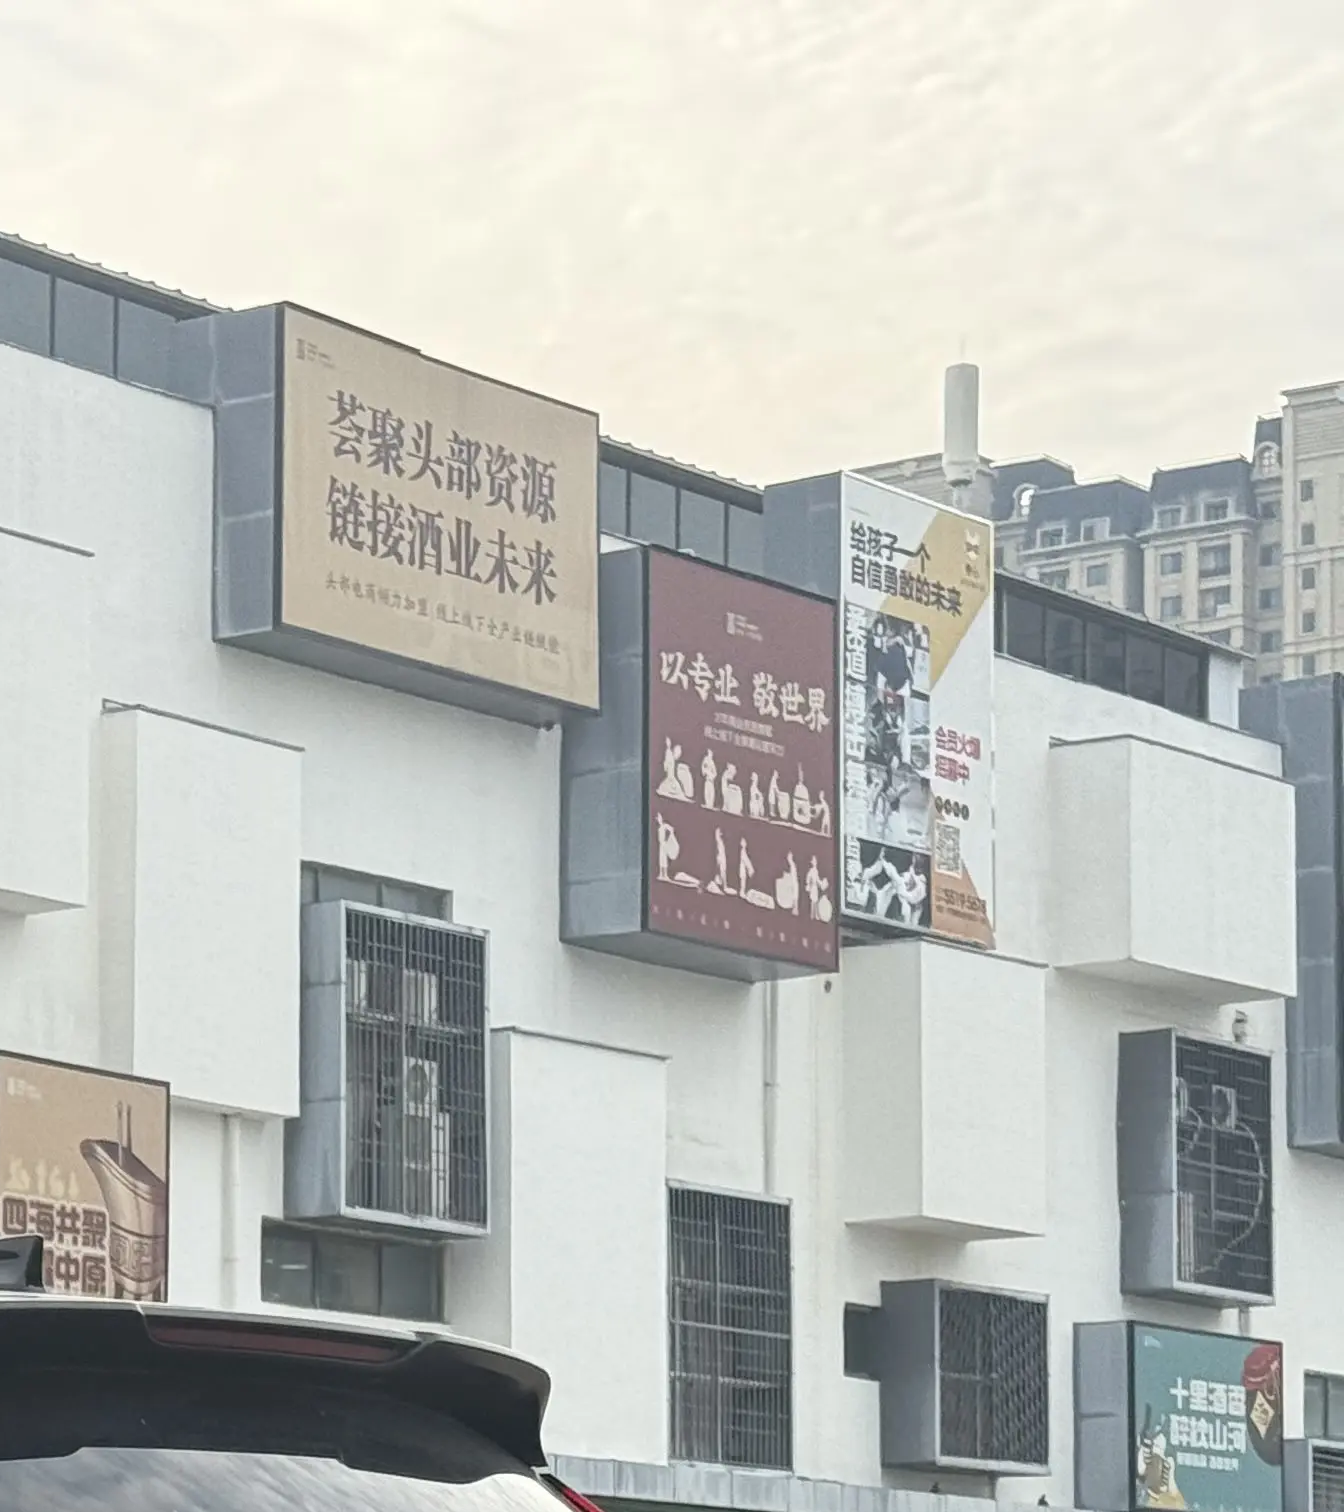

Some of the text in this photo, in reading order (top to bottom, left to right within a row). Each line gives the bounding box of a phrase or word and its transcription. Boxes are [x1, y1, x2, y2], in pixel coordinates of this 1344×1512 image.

[325, 389, 558, 524] 荟聚头部资源
[325, 475, 558, 605] 链接酒业未来
[849, 520, 931, 574] 给孩子一个
[850, 555, 963, 618] 自信勇敢的未来
[660, 651, 741, 706] 以专业
[2, 1197, 108, 1248] 四海共聚
[1169, 1376, 1246, 1416] 十里酒香
